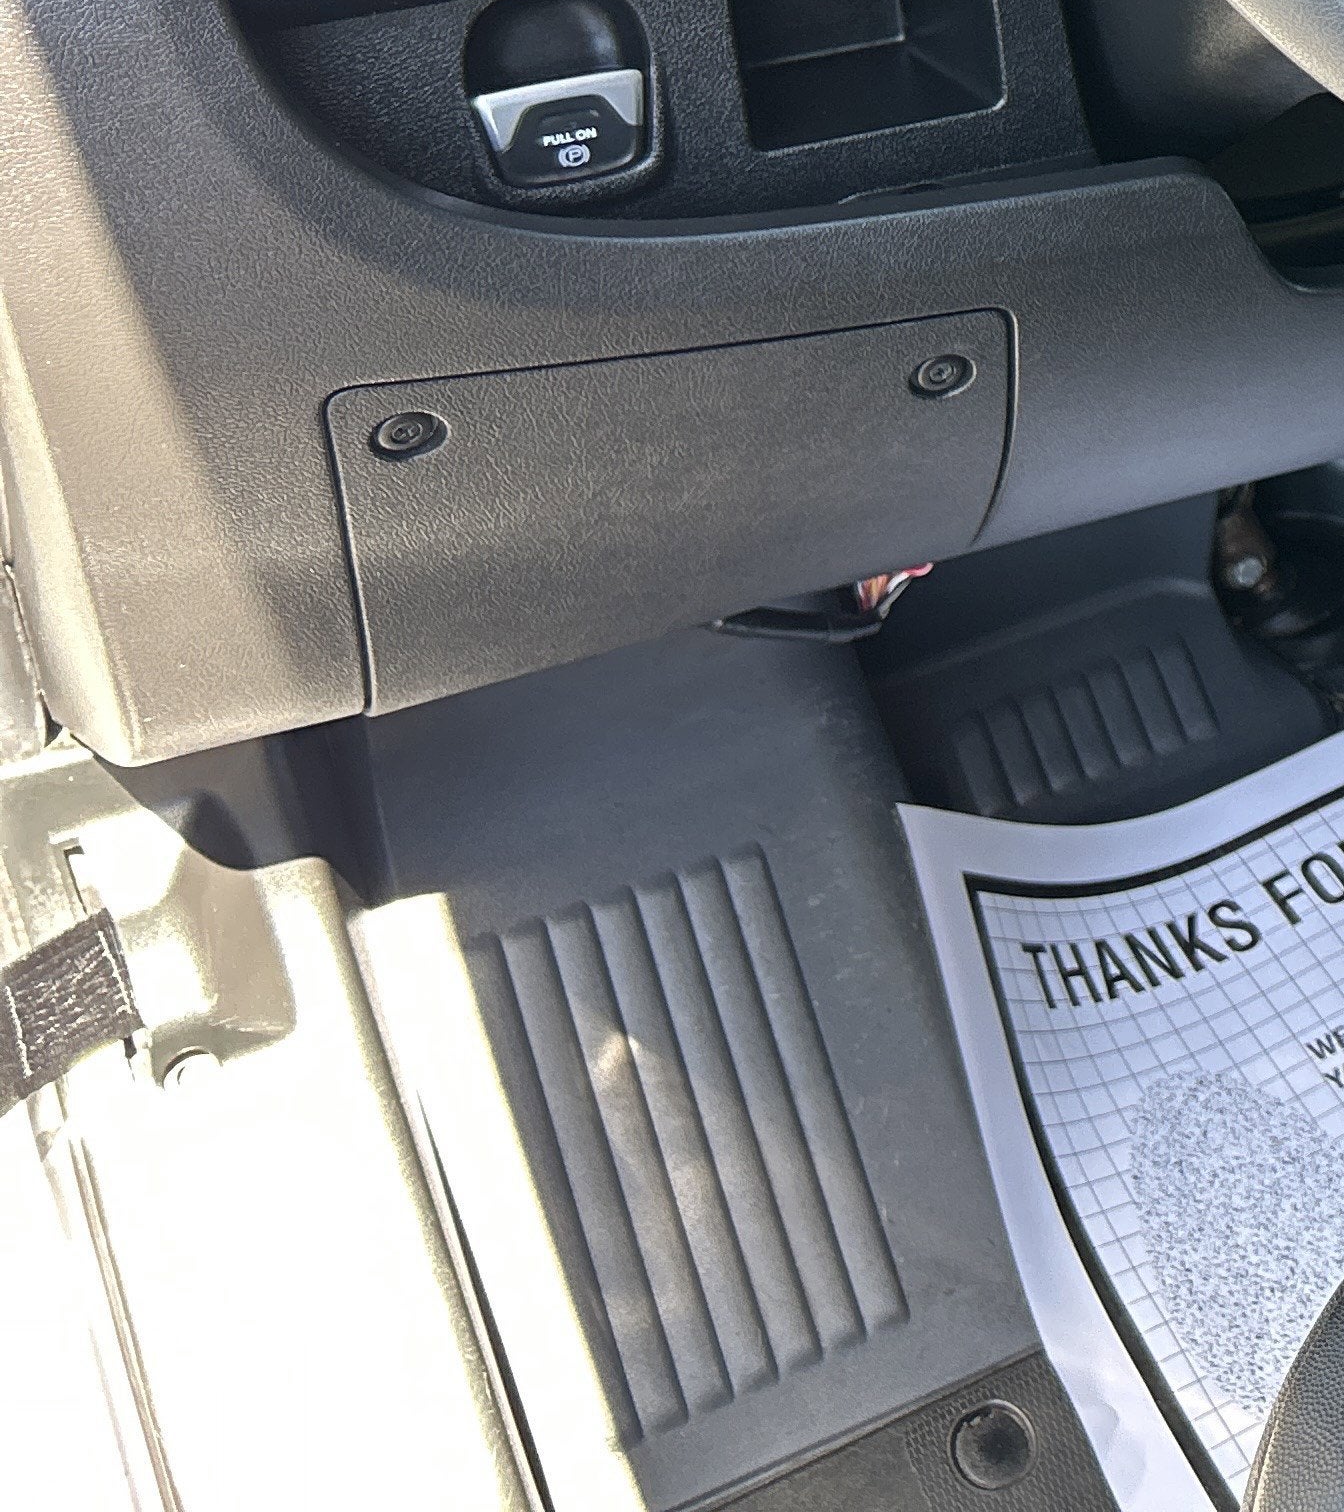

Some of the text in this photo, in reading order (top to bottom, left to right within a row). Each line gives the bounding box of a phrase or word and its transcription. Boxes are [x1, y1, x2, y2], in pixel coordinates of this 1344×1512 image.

[542, 126, 598, 147] PULL ON
[1020, 899, 1263, 1011] THANKS
